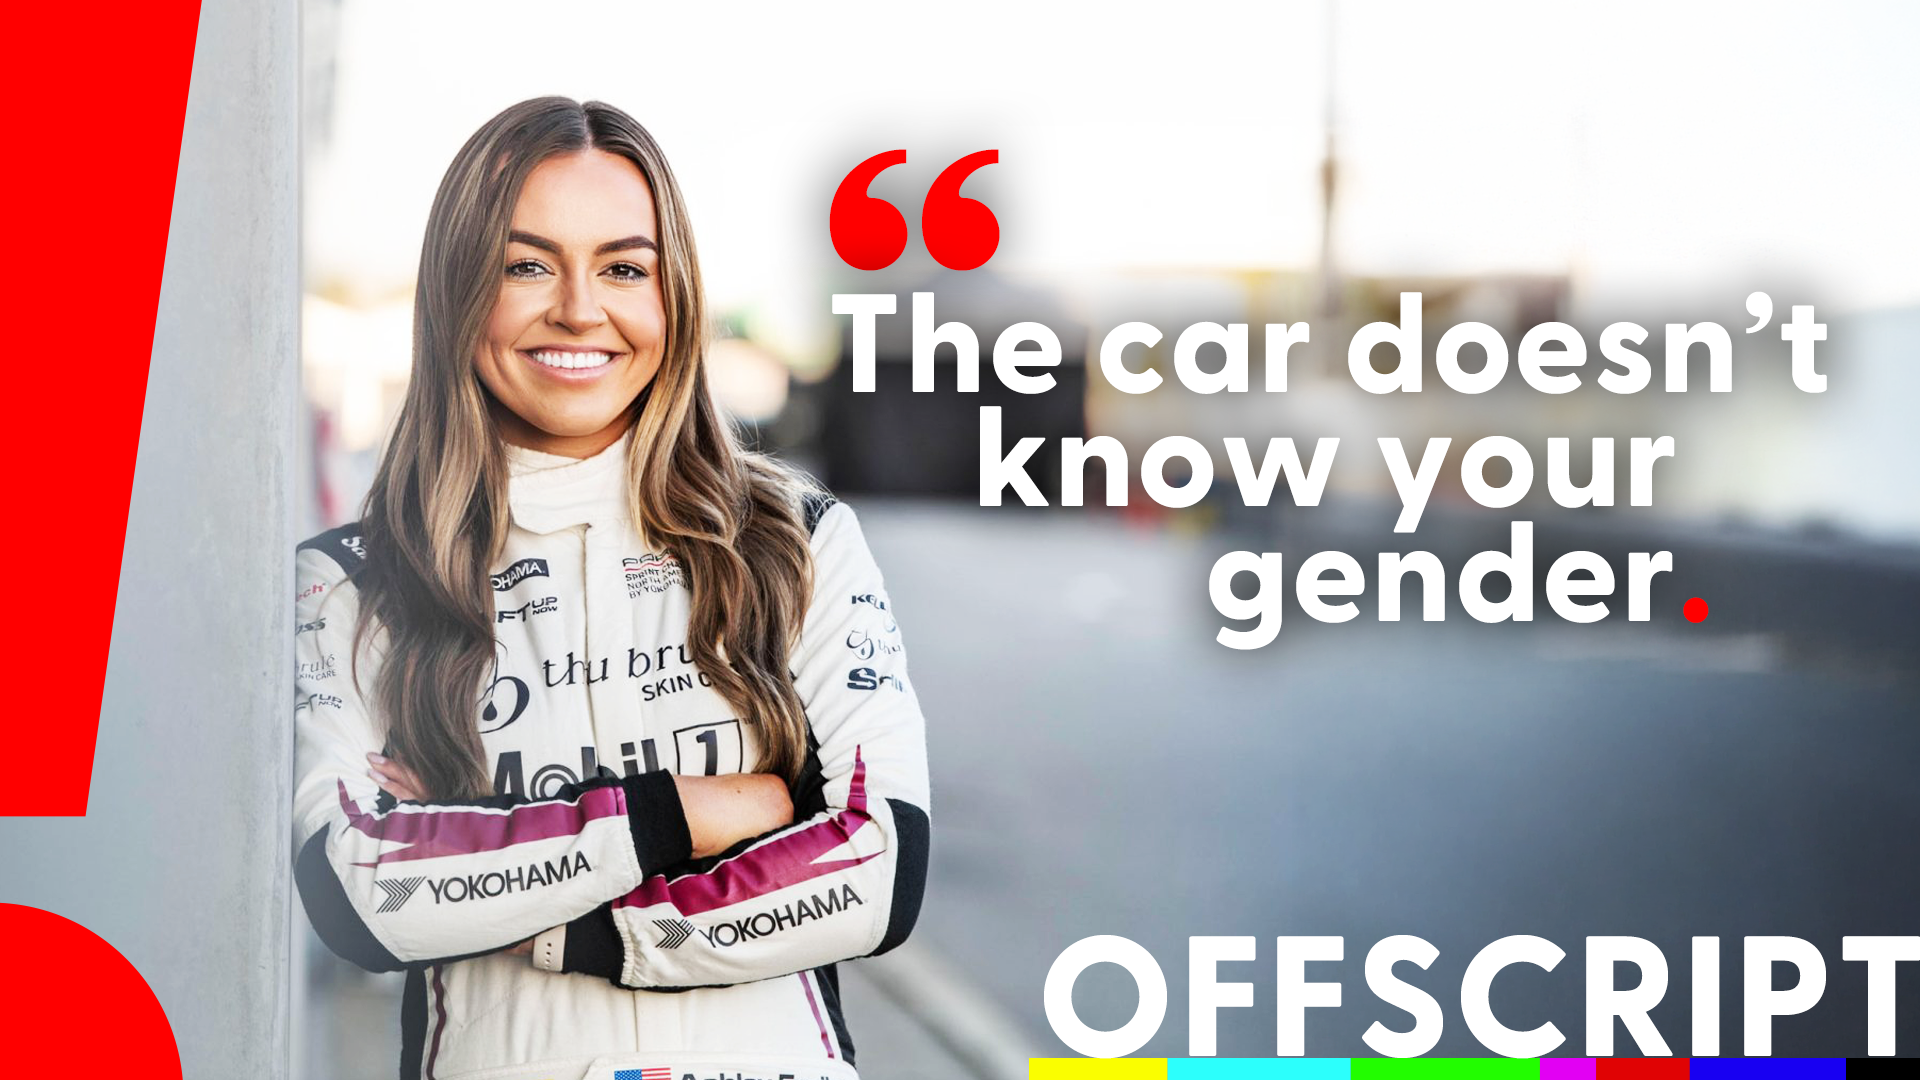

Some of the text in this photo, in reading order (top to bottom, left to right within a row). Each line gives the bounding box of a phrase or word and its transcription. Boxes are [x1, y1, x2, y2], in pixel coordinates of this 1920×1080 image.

[490, 561, 542, 589] OHAMA
[625, 568, 660, 582] SPRINT
[627, 577, 661, 591] NORTH
[531, 596, 558, 609] UP
[629, 590, 642, 600] BY
[532, 606, 558, 616] NOW
[316, 669, 338, 681] CARE
[542, 643, 695, 688] thu bru
[641, 673, 693, 702] SKIN
[695, 729, 718, 777] 1
[427, 850, 592, 904] YOKOHAMA
[699, 883, 864, 948] YOKOHAMA
